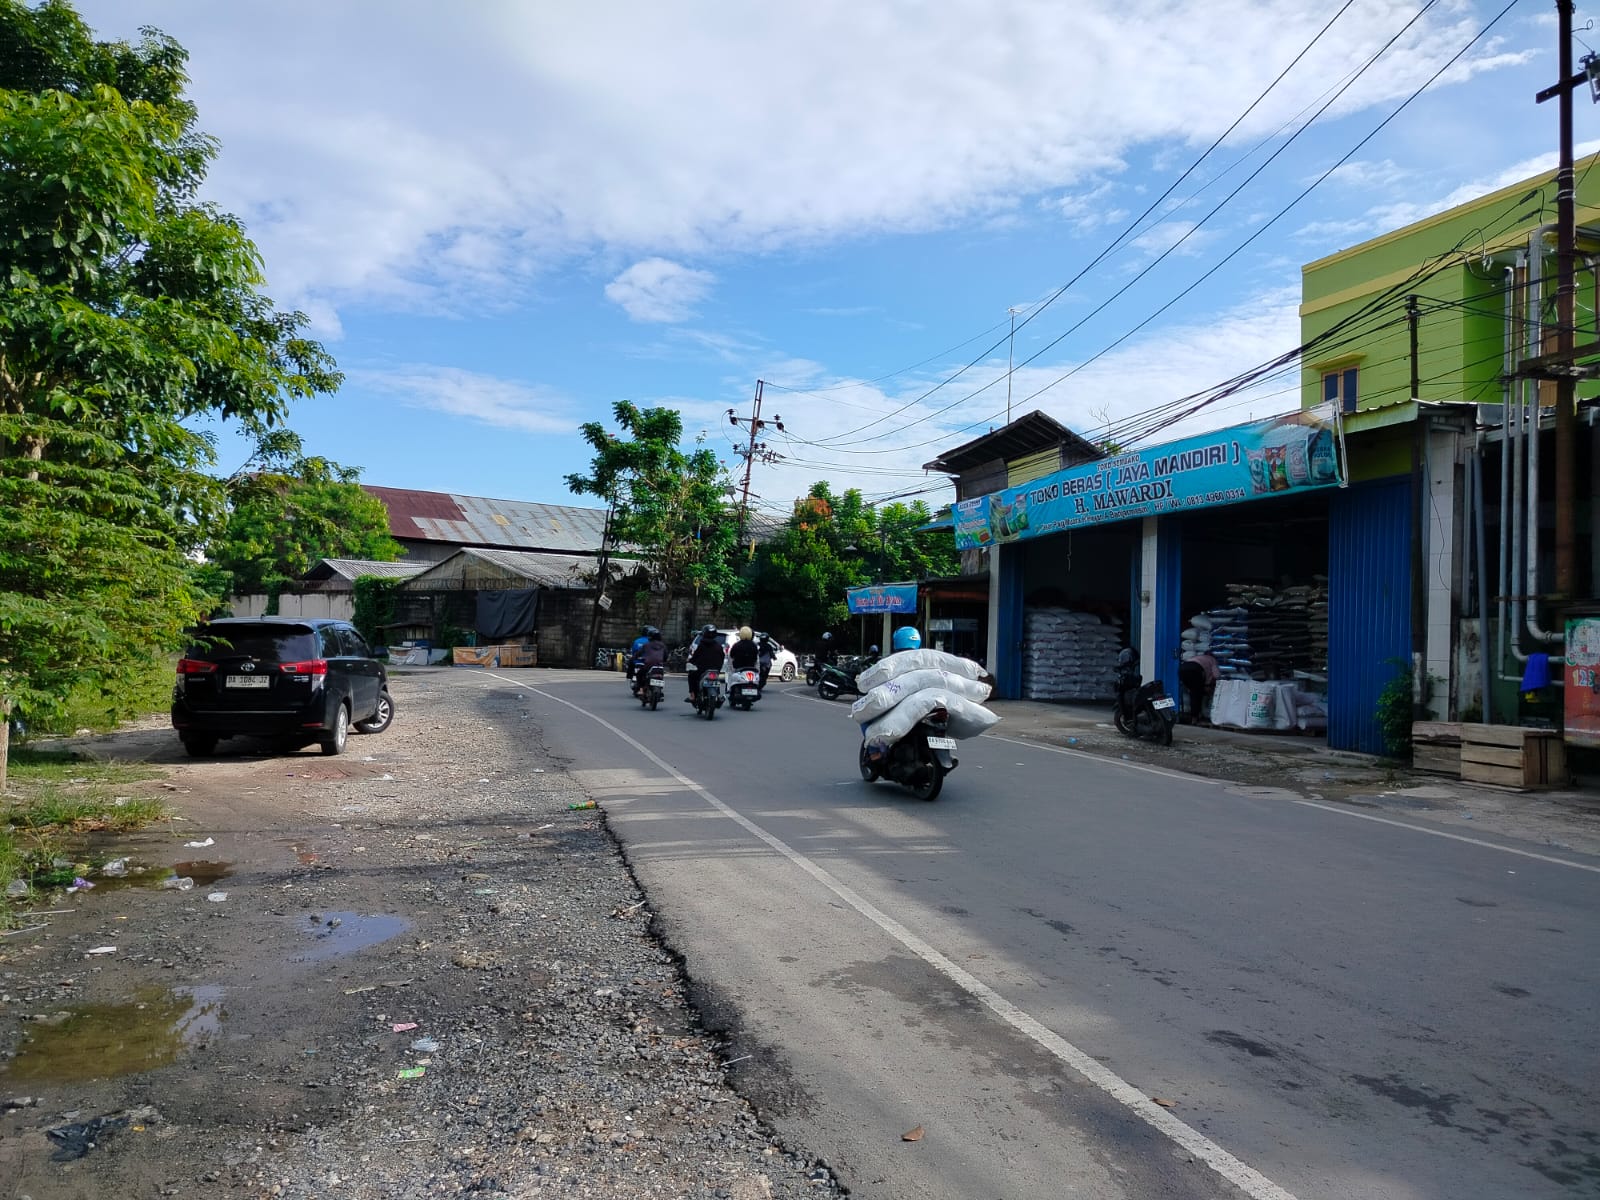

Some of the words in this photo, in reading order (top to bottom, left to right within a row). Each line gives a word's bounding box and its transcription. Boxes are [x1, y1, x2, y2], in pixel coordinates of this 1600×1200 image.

[1030, 483, 1059, 506] TOKO
[1062, 473, 1103, 497] BERAS
[1115, 463, 1150, 485] JAYA
[1154, 442, 1228, 477] MANDIRI
[1074, 497, 1090, 515] H.
[1092, 479, 1173, 511] MAWARDI
[1186, 494, 1205, 506] 0813
[1225, 487, 1246, 500] 0314
